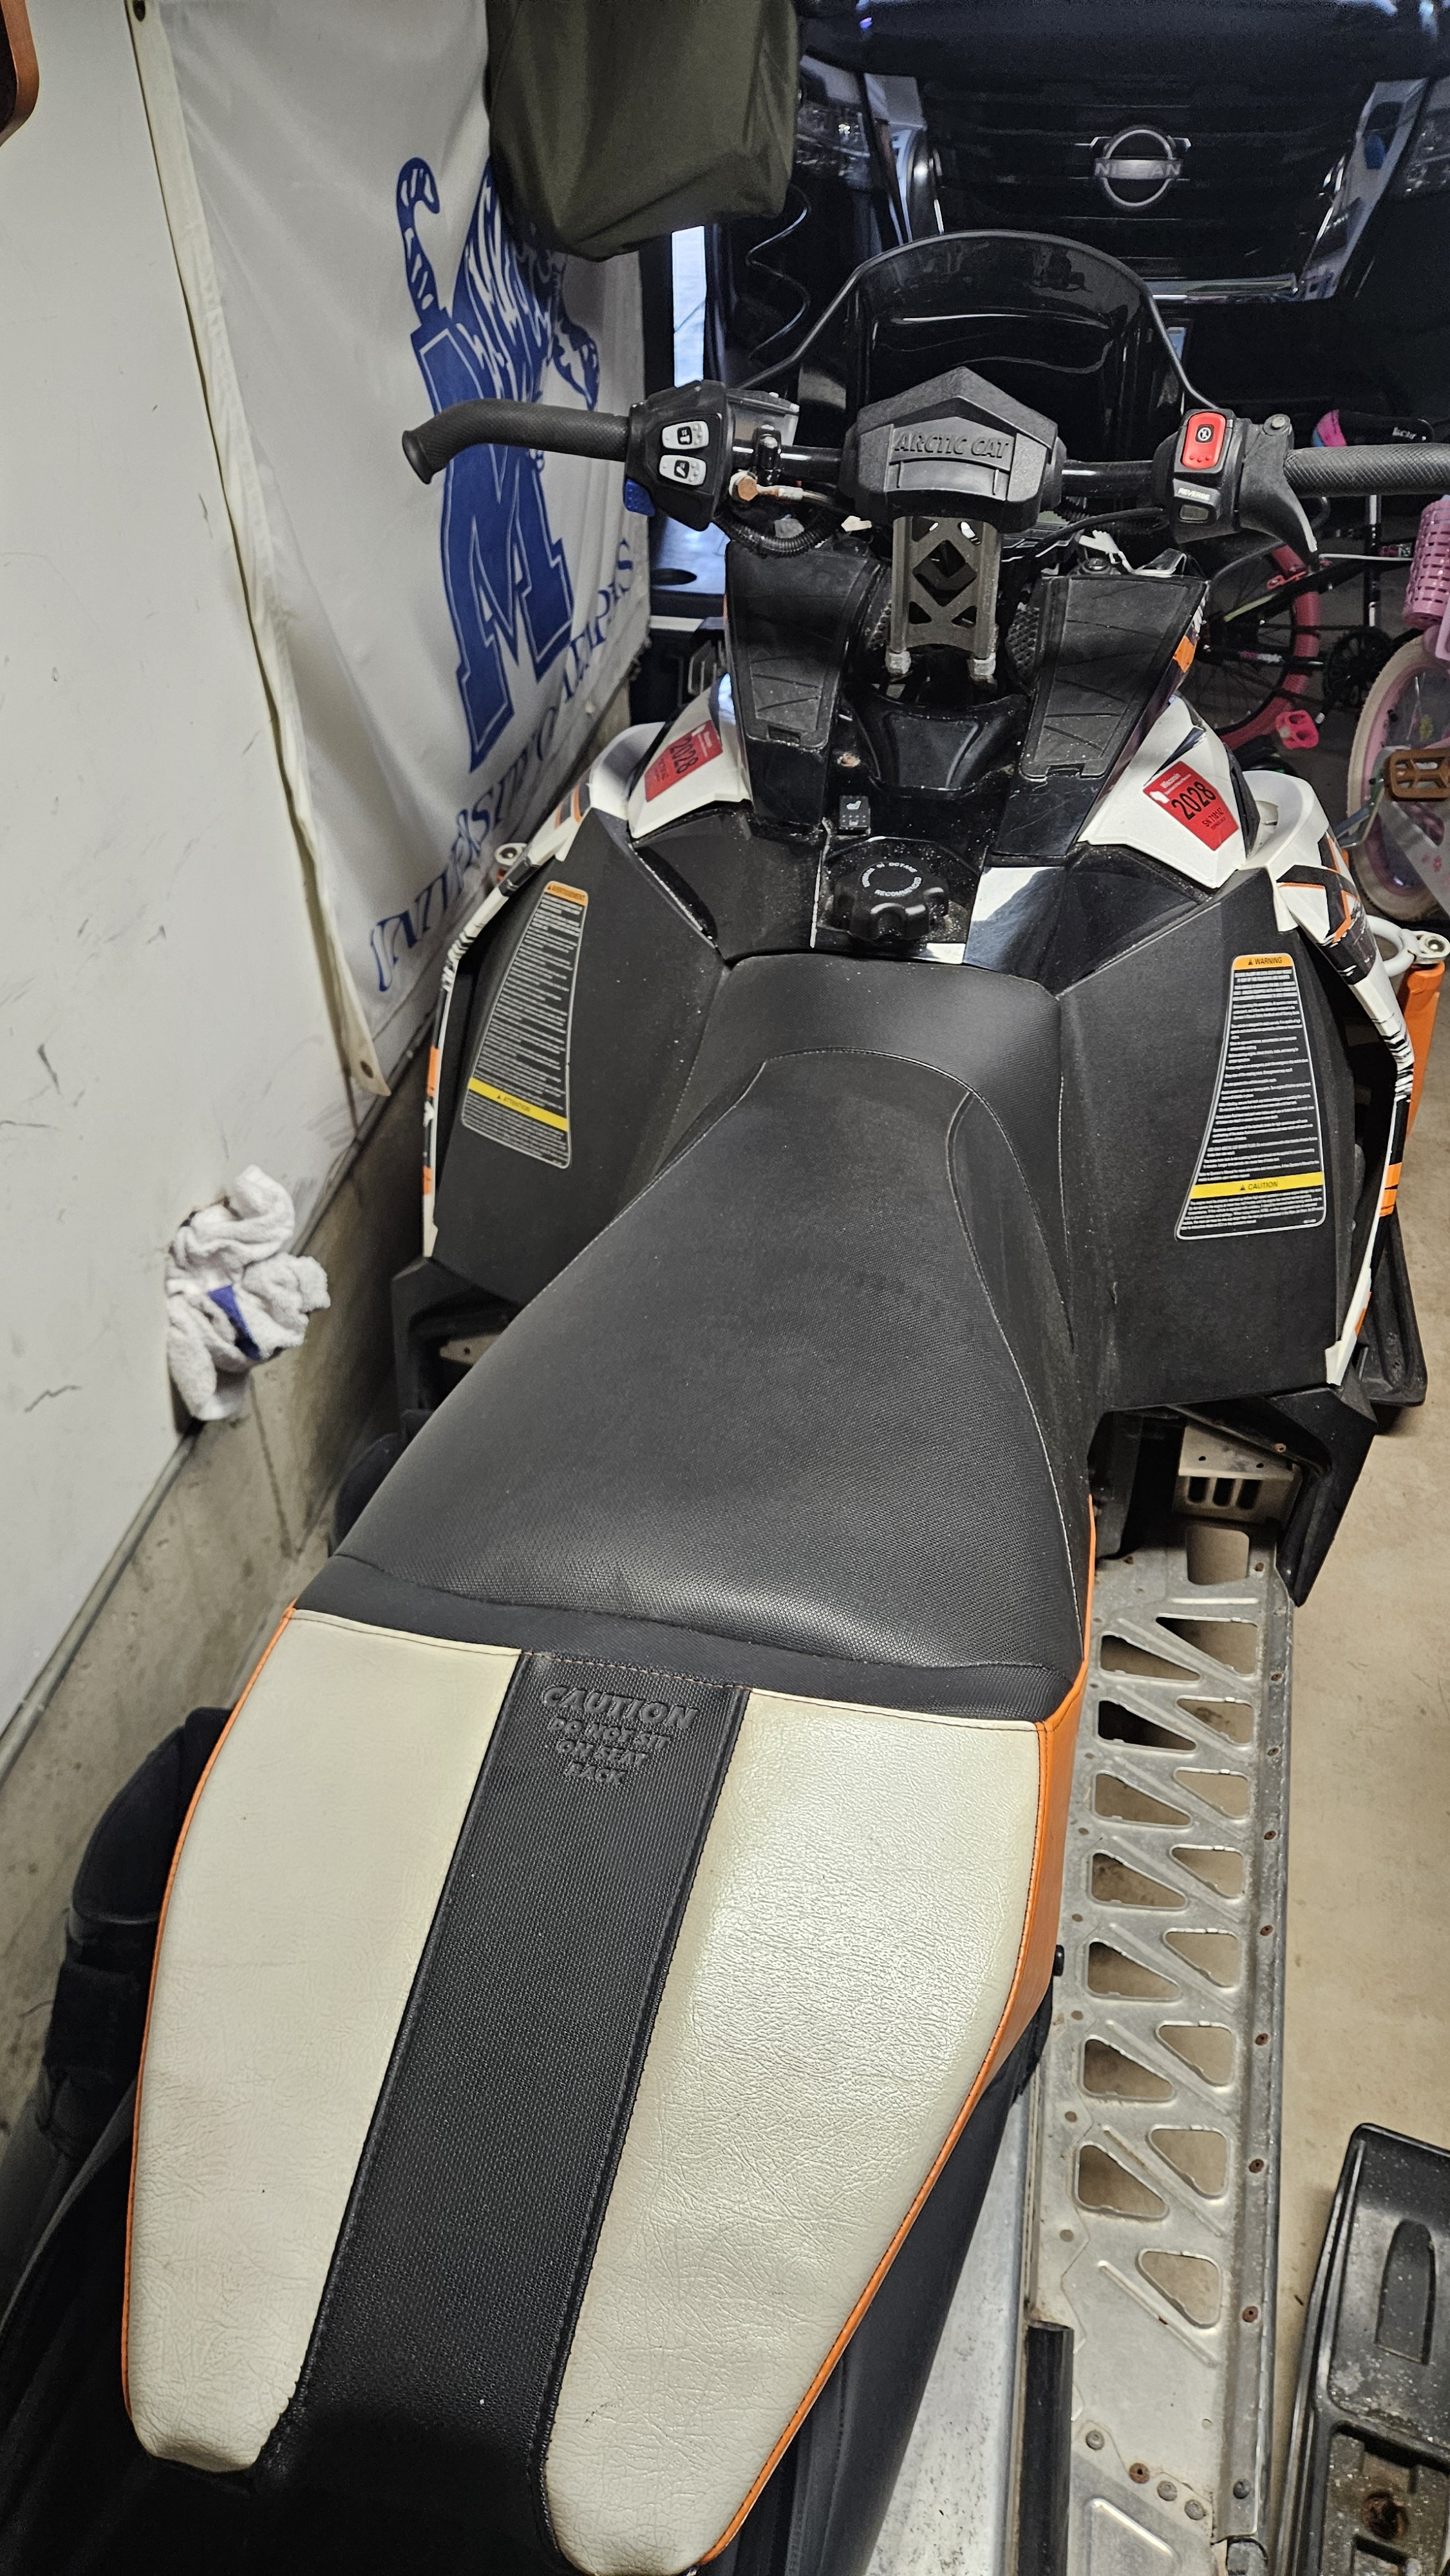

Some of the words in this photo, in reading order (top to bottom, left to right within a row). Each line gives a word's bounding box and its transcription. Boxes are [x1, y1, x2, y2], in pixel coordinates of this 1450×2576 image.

[1095, 162, 1182, 176] NISSAN
[894, 432, 967, 455] ARCTIC
[971, 436, 1009, 459] CAT
[1178, 488, 1211, 500] REVERSE
[670, 737, 699, 774] 2028
[1171, 781, 1216, 820] 2028
[1248, 1181, 1278, 1191] CAUTION
[543, 1685, 699, 1729] CAUTION
[548, 1717, 581, 1733] DO
[585, 1722, 635, 1743] NOT
[634, 1731, 670, 1750] SIT
[557, 1739, 594, 1757] ON
[594, 1745, 646, 1766] SEAT
[565, 1761, 626, 1784] BACK
